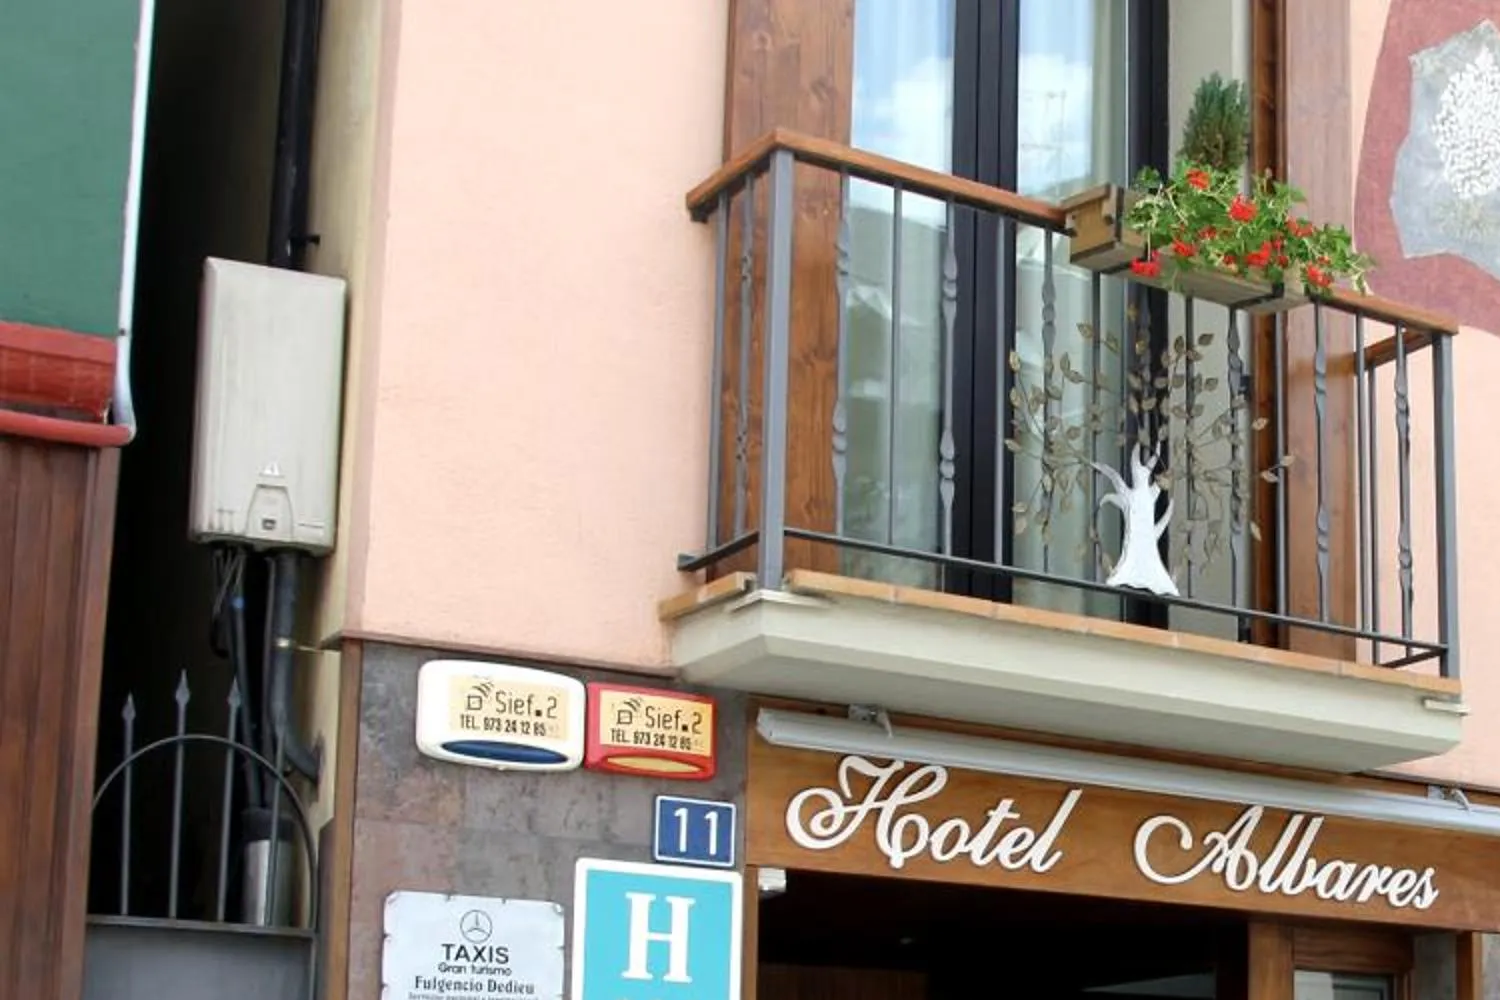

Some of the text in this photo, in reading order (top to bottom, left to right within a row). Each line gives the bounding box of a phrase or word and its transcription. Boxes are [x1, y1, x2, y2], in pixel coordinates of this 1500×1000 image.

[673, 807, 719, 856] 11
[784, 754, 1440, 909] Hotel Albares
[441, 943, 509, 965] TAXIS
[620, 891, 697, 984] H
[415, 975, 483, 993] Fulgencio
[437, 962, 467, 974] Gran
